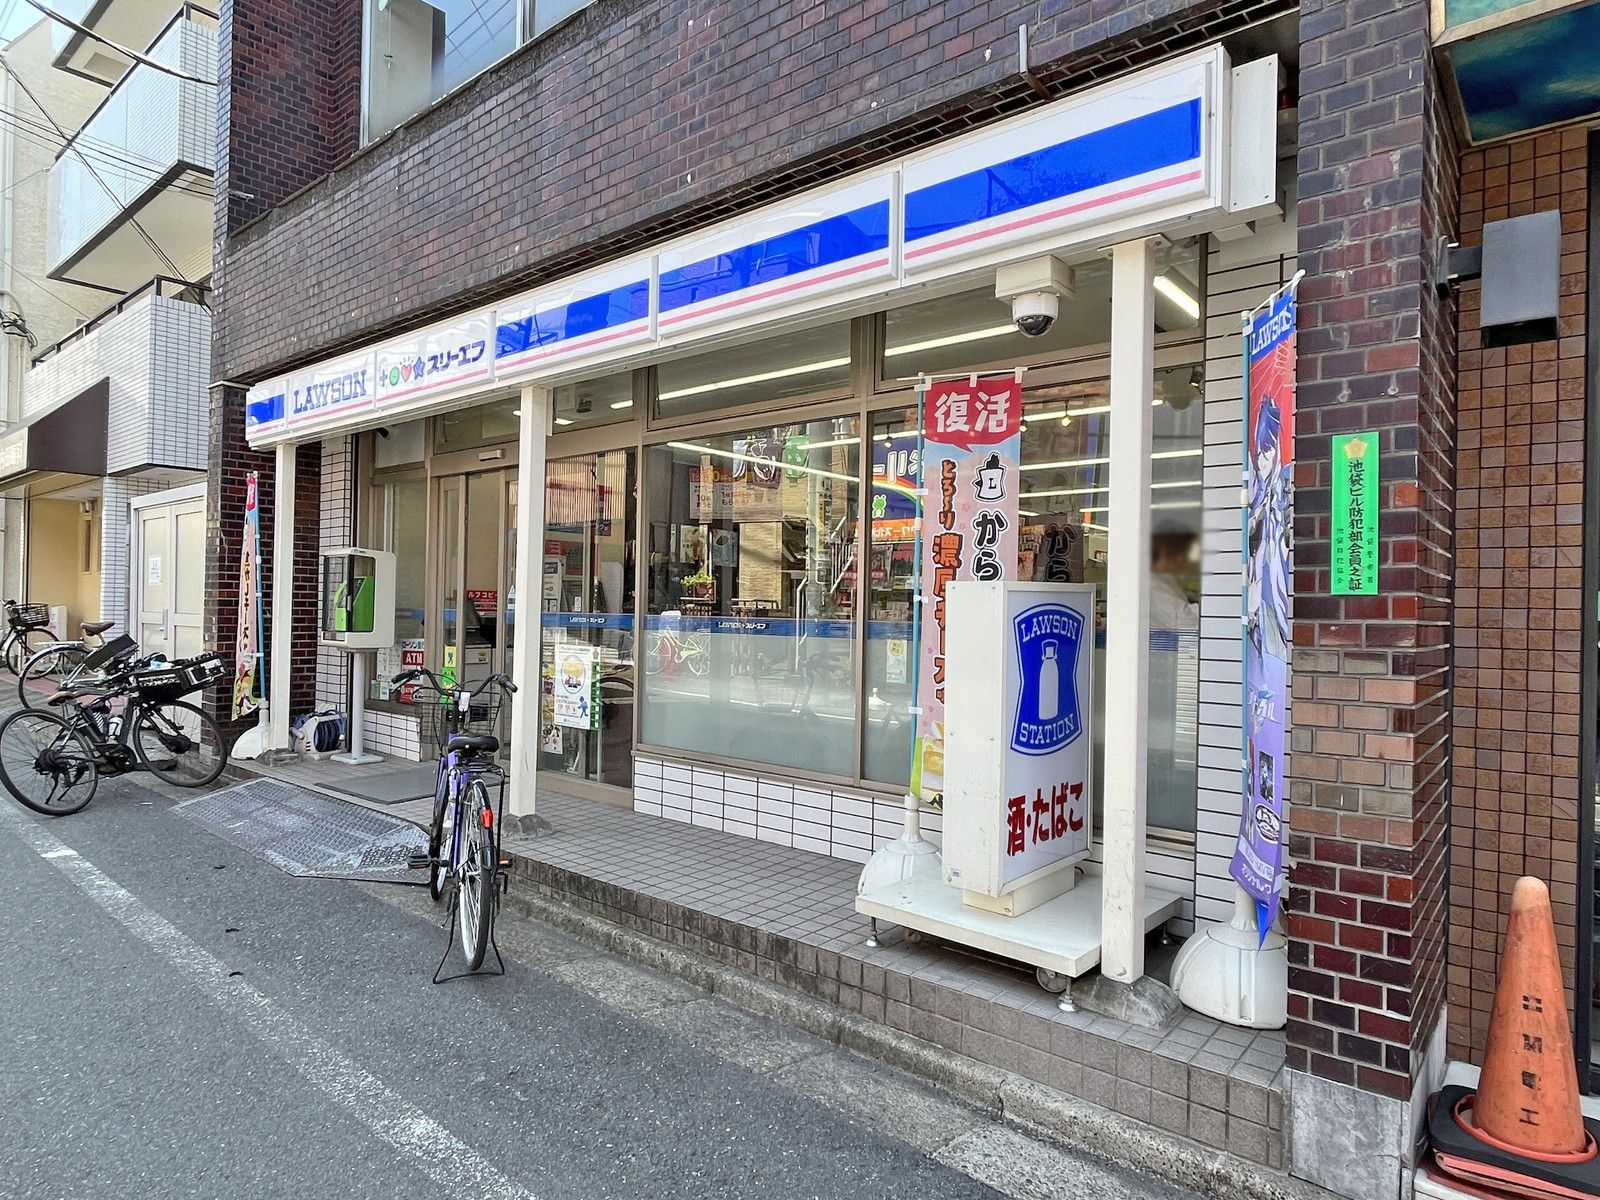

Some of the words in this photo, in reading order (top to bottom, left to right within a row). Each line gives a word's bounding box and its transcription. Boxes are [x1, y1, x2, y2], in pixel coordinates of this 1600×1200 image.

[1251, 302, 1293, 355] LAWS
[427, 340, 485, 375] スリーエフ
[293, 369, 367, 414] LAWSON
[934, 390, 1011, 433] 復活
[1021, 615, 1077, 642] LAWSON
[405, 652, 423, 664] ATM
[1020, 713, 1074, 744] STATION
[1007, 781, 1083, 857] 酒・たばこ
